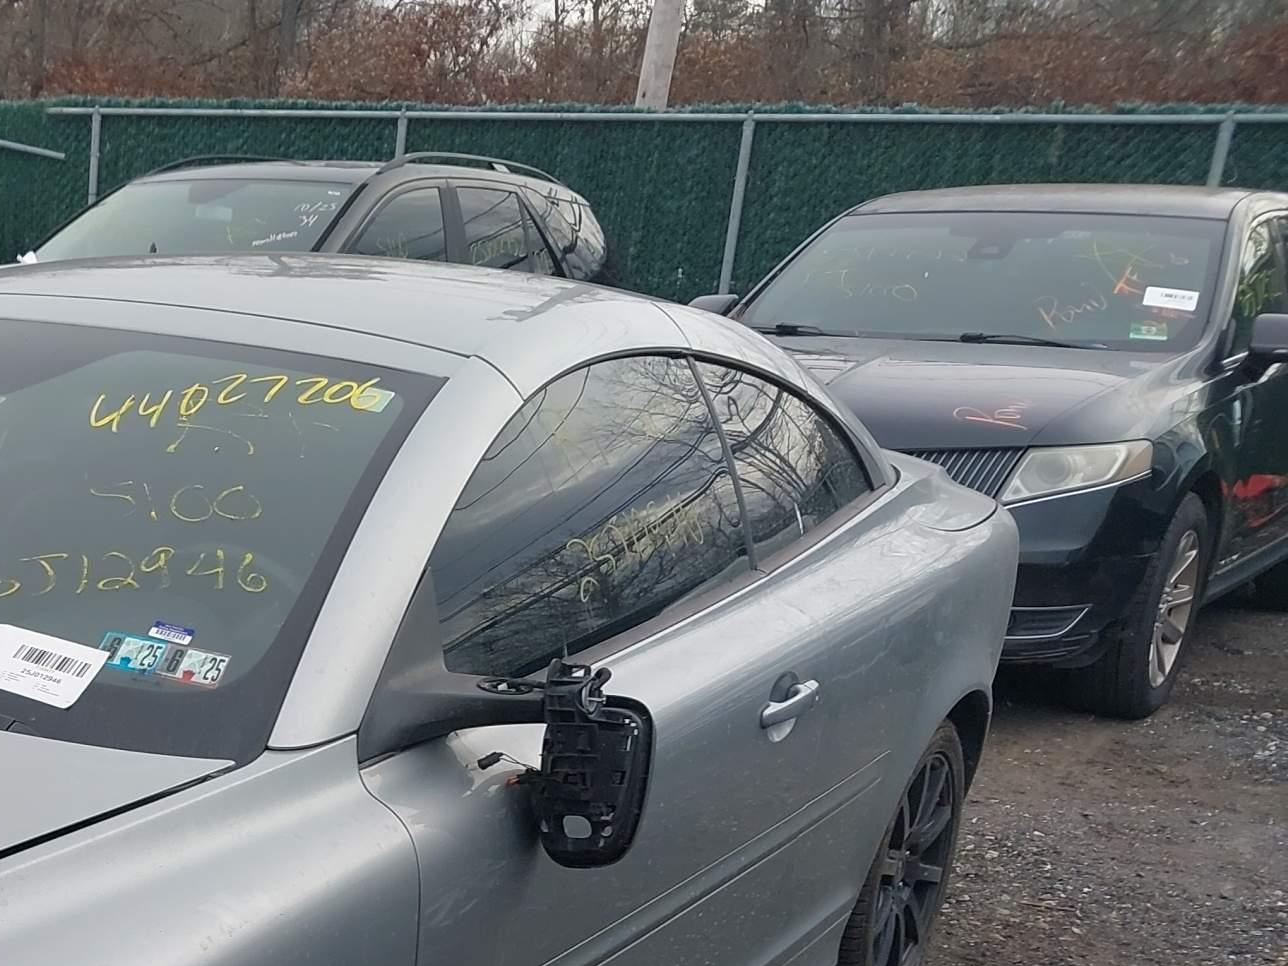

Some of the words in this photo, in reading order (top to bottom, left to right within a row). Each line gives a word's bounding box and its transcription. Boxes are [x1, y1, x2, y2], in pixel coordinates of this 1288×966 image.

[89, 373, 382, 433] 44027206
[139, 644, 163, 668] 25
[166, 649, 185, 673] 6
[202, 657, 226, 682] 25
